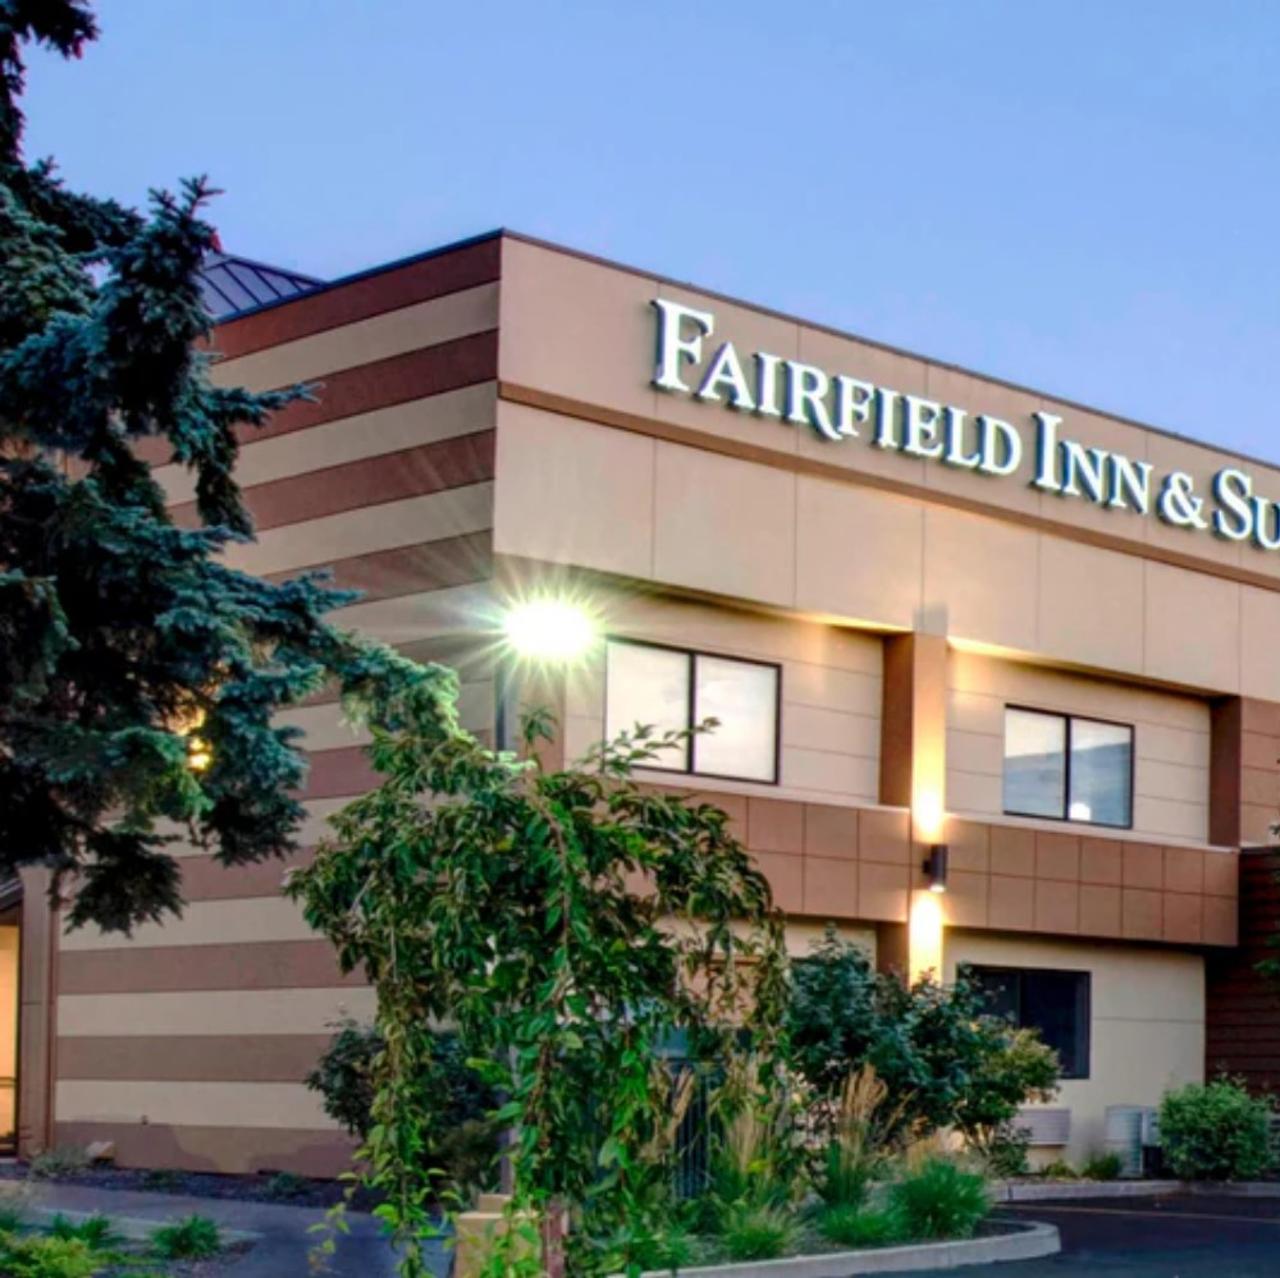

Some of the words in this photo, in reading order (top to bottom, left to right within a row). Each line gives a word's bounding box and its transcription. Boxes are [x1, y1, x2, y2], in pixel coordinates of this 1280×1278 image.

[653, 298, 1023, 476] FAIRFIELD
[1033, 410, 1153, 515] INN
[1160, 471, 1208, 529] &
